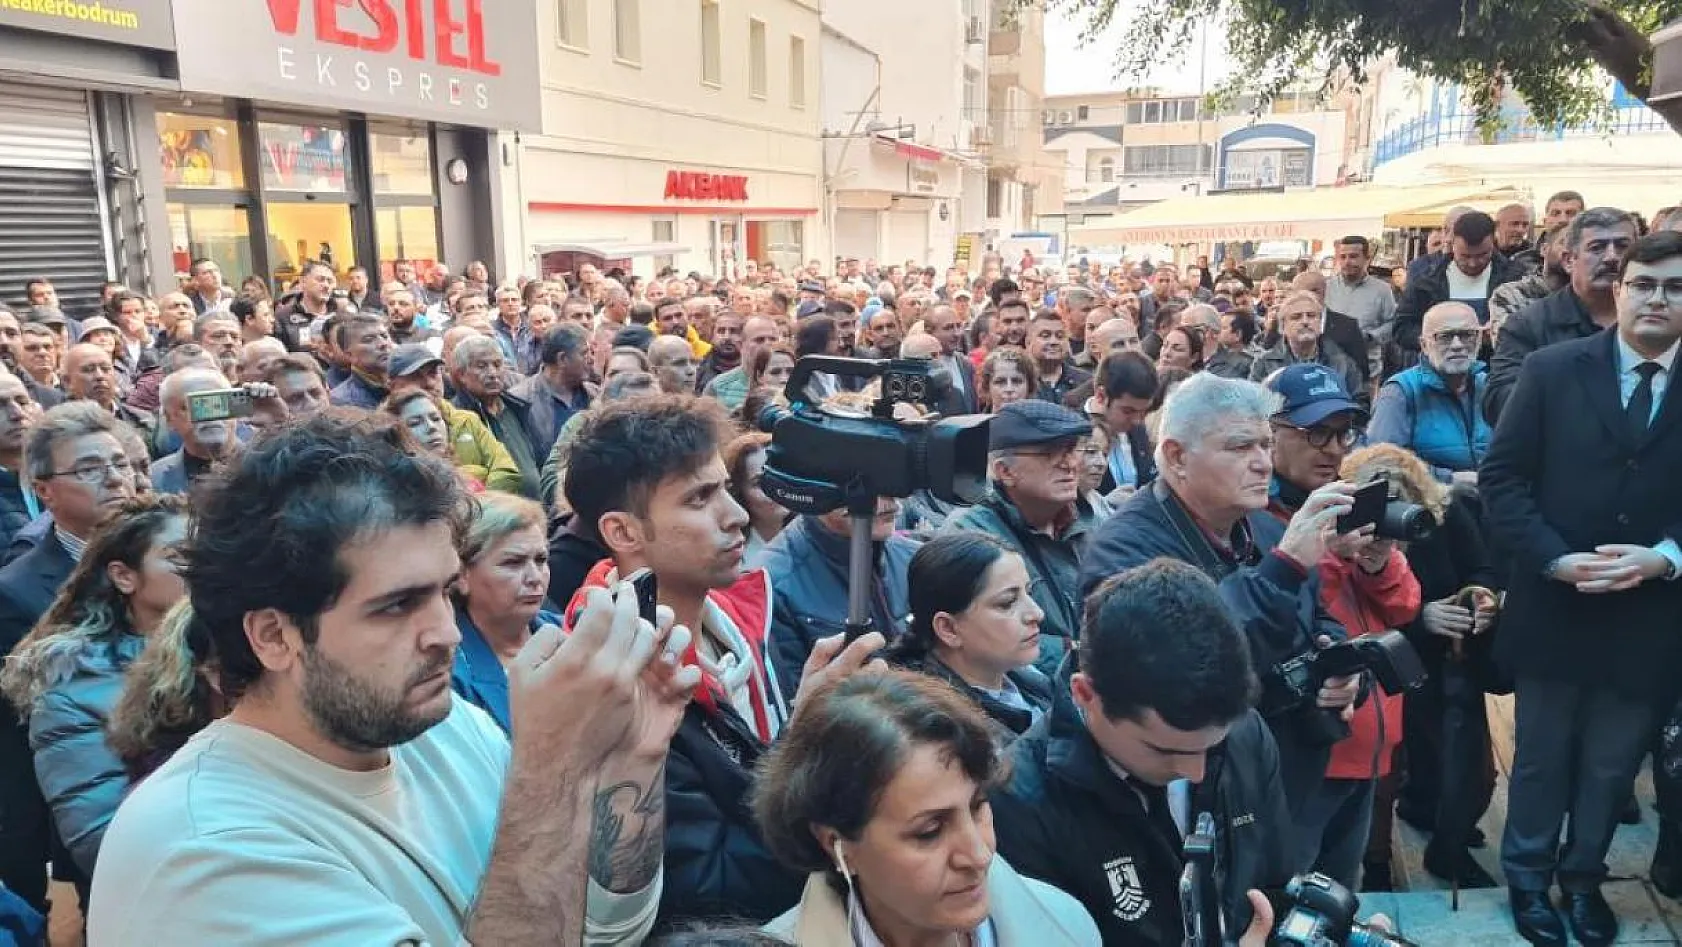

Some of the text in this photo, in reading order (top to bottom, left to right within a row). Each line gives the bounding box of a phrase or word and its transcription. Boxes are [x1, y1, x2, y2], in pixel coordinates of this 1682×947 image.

[278, 47, 488, 109] EKSPRES
[664, 170, 748, 201] AKBANK
[777, 488, 813, 504] Canon
